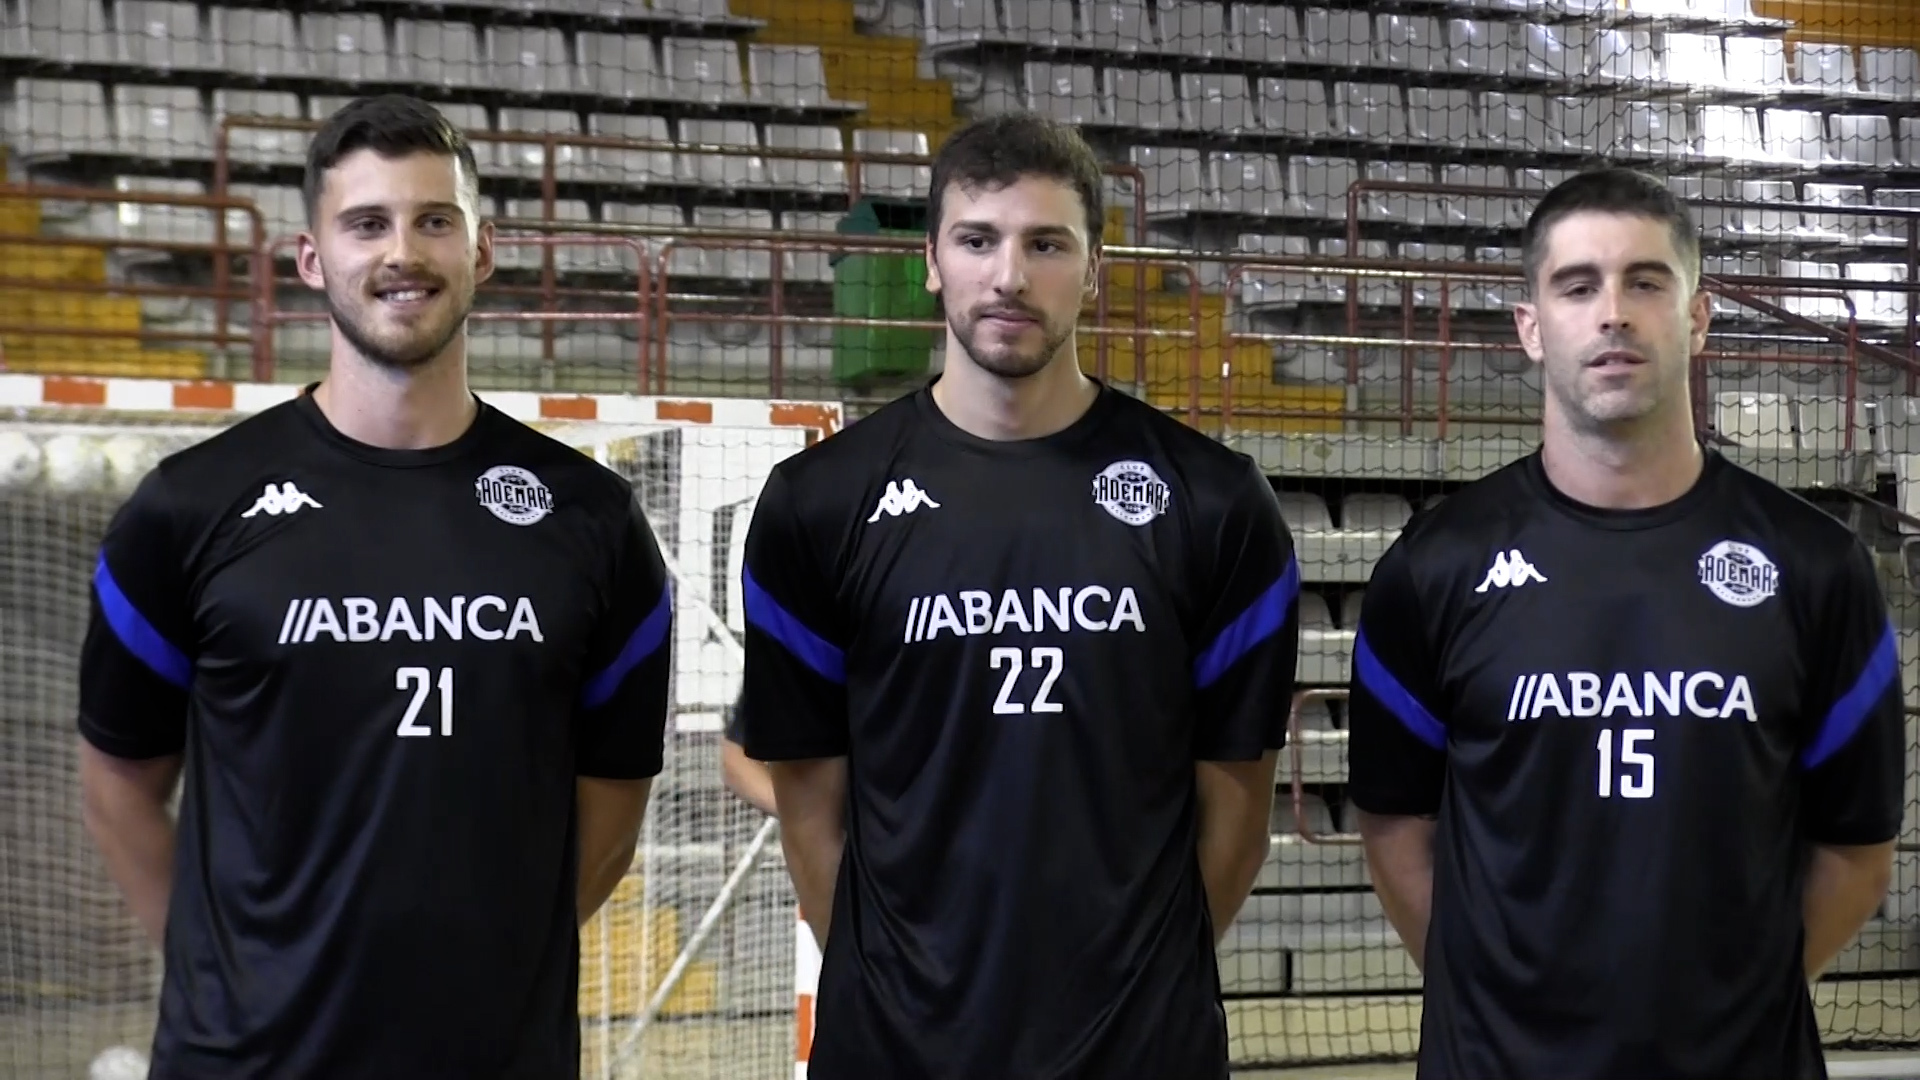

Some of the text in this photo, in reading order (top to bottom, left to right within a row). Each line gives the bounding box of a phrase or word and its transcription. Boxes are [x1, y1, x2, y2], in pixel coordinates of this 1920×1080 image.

[396, 666, 453, 737] 21
[989, 646, 1064, 715] 22
[1596, 728, 1655, 799] 15
